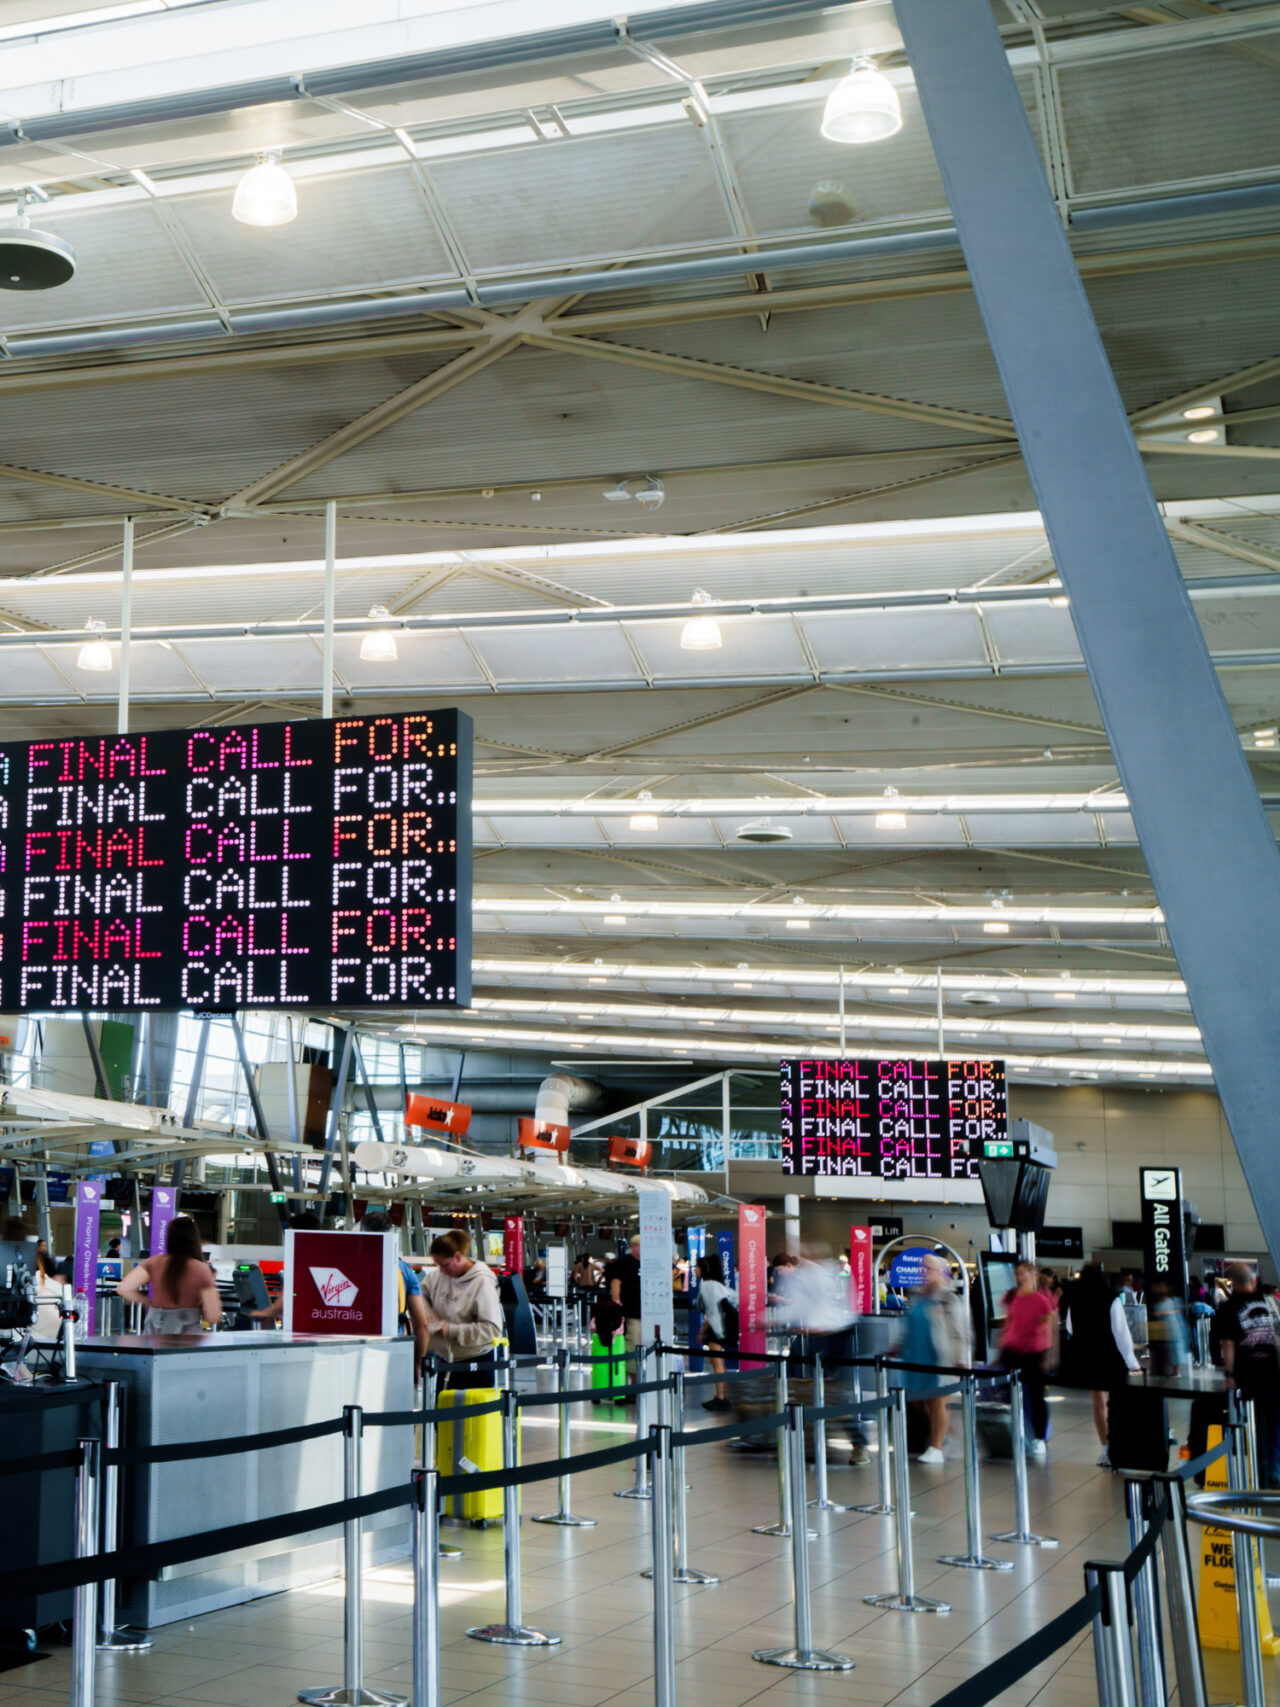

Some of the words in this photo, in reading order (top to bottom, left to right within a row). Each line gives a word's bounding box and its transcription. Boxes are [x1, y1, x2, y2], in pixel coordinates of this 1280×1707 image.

[28, 737, 166, 783] FINAL
[188, 726, 312, 772] CALL
[27, 781, 166, 827] FINAL
[186, 772, 312, 817] CALL
[26, 827, 164, 871] FINAL
[185, 818, 311, 864] CALL
[23, 872, 163, 917] FINAL
[184, 866, 310, 910] CALL
[22, 918, 162, 961] FINAL
[183, 913, 309, 956] CALL
[20, 963, 161, 1007] FINAL
[181, 960, 309, 1003] CALL
[197, 1011, 233, 1019] JCDecaux
[800, 1061, 869, 1079] FINAL
[878, 1061, 938, 1079] CALL
[800, 1080, 870, 1098] FINAL
[878, 1080, 939, 1099] CALL
[801, 1099, 870, 1117] FINAL
[879, 1099, 939, 1118] CALL
[801, 1118, 871, 1137] FINAL
[879, 1119, 940, 1138] CALL
[802, 1137, 871, 1156] FINAL
[880, 1138, 941, 1157] CALL
[802, 1156, 872, 1176] FINAL
[881, 1157, 942, 1177] CALL
[1153, 1203, 1171, 1225] All
[83, 1216, 93, 1249] Priority
[158, 1220, 167, 1252] Priority
[885, 1227, 899, 1236] Lift
[902, 1255, 923, 1264] Rotary
[1154, 1227, 1171, 1273] Gates
[83, 1250, 92, 1291] Check-in
[748, 1240, 757, 1282] Check-in
[896, 1265, 928, 1274] CHARITY
[320, 1273, 353, 1304] Virgin
[747, 1293, 757, 1311] Bag
[311, 1308, 363, 1321] australia
[1210, 1542, 1233, 1556] WE
